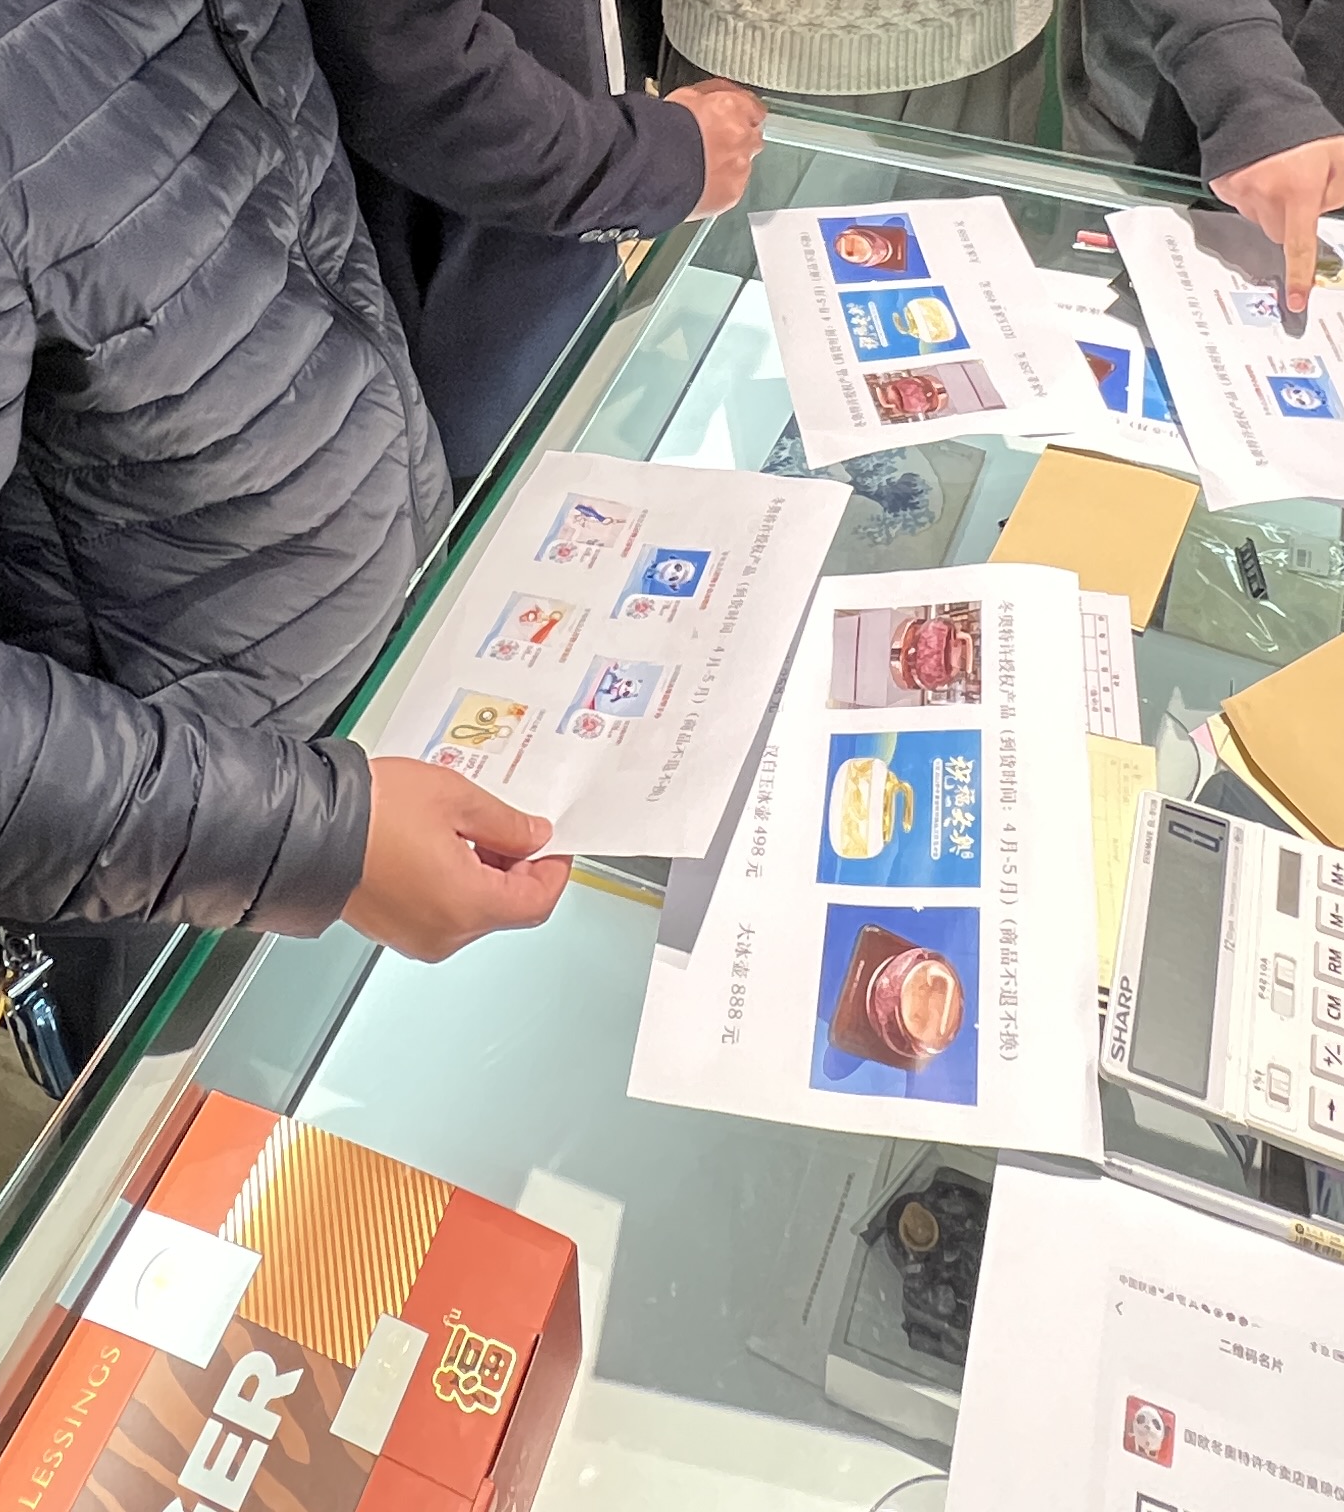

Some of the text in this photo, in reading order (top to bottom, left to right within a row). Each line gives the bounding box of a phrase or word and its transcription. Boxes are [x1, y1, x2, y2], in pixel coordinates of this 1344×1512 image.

[752, 826, 769, 857] 498
[746, 859, 766, 878] 元
[1330, 861, 1344, 885] M+
[1329, 948, 1343, 974] RM
[722, 922, 757, 1045] 大冰壶 888 元
[1111, 975, 1131, 1062] SHARP
[1328, 994, 1342, 1019] CM
[18, 1343, 121, 1511] LESSINGS
